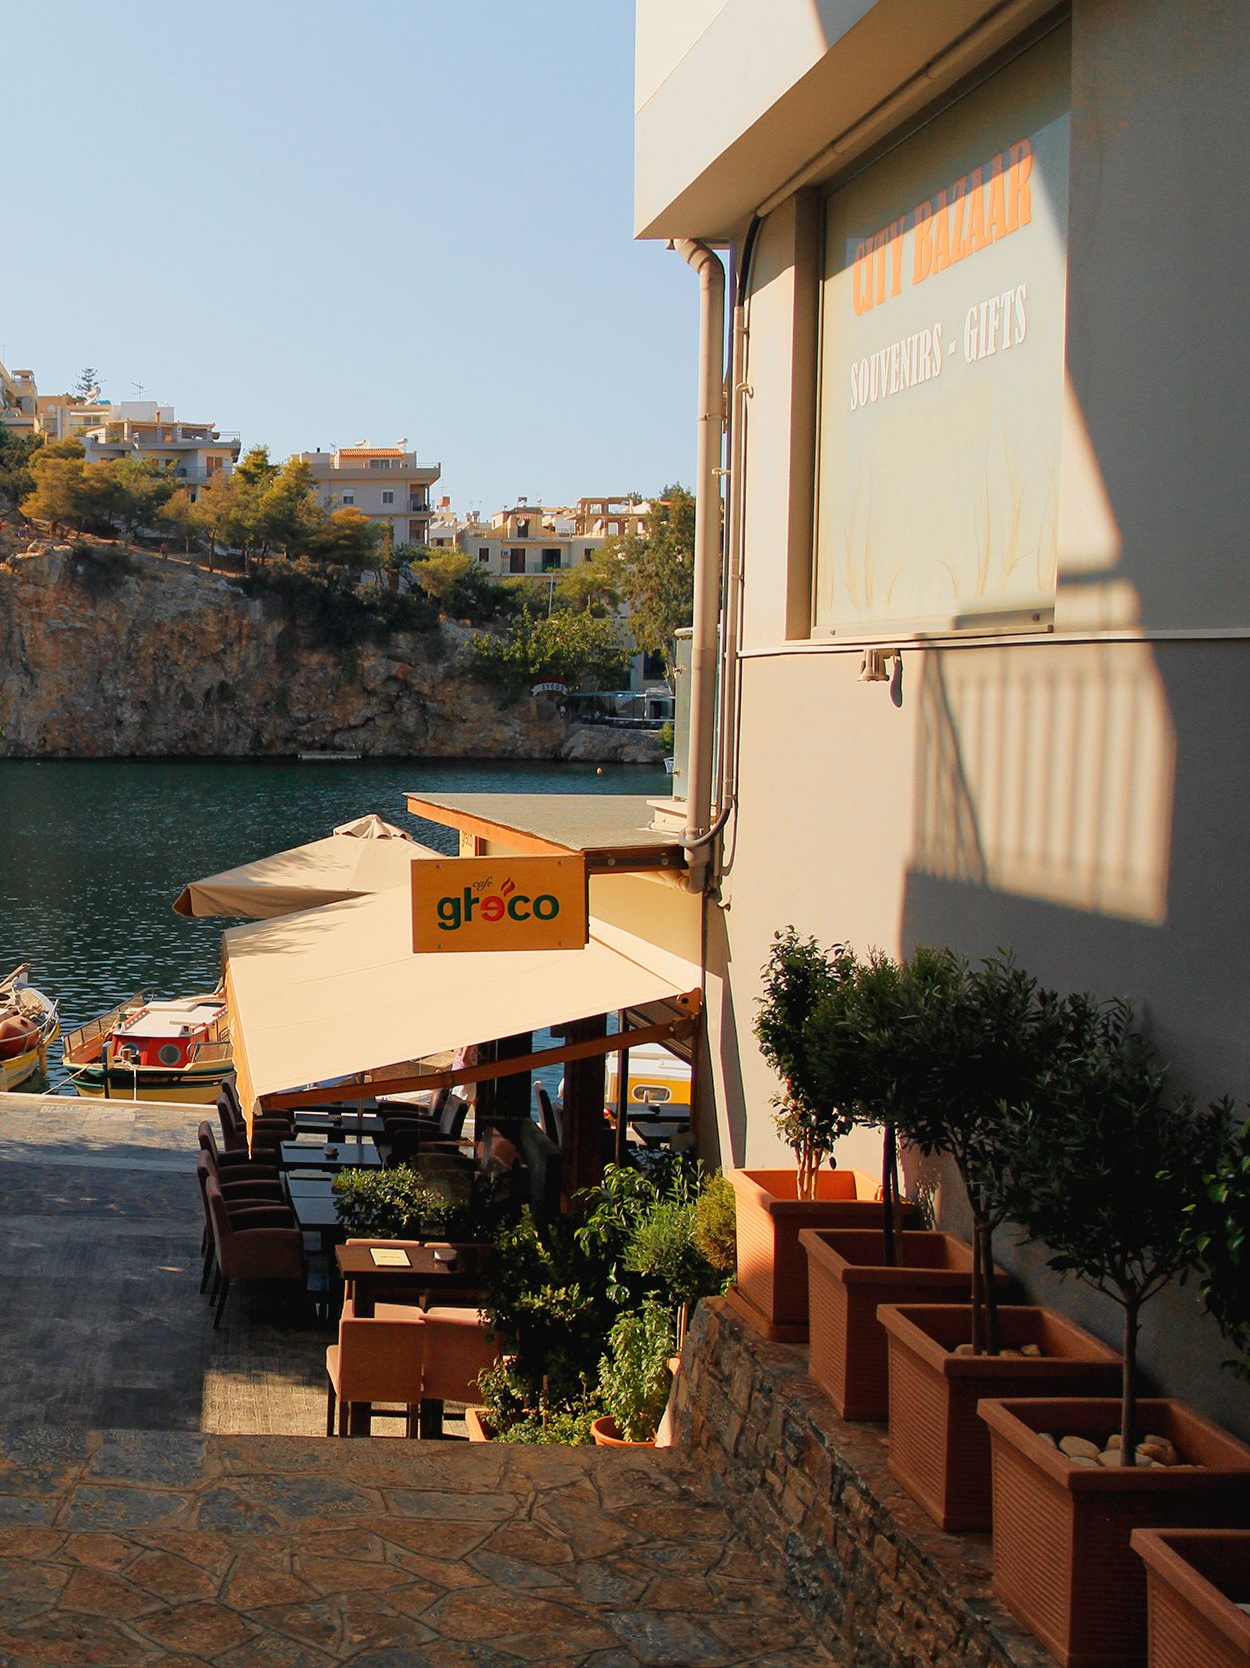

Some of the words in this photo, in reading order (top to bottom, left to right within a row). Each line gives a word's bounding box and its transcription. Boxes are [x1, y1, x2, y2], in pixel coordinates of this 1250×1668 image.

[852, 214, 906, 317] CITY
[912, 136, 1033, 286] BAZAAR
[850, 321, 942, 411] SOUVENIRS
[963, 282, 1028, 364] GIFTS
[437, 886, 560, 931] greco
